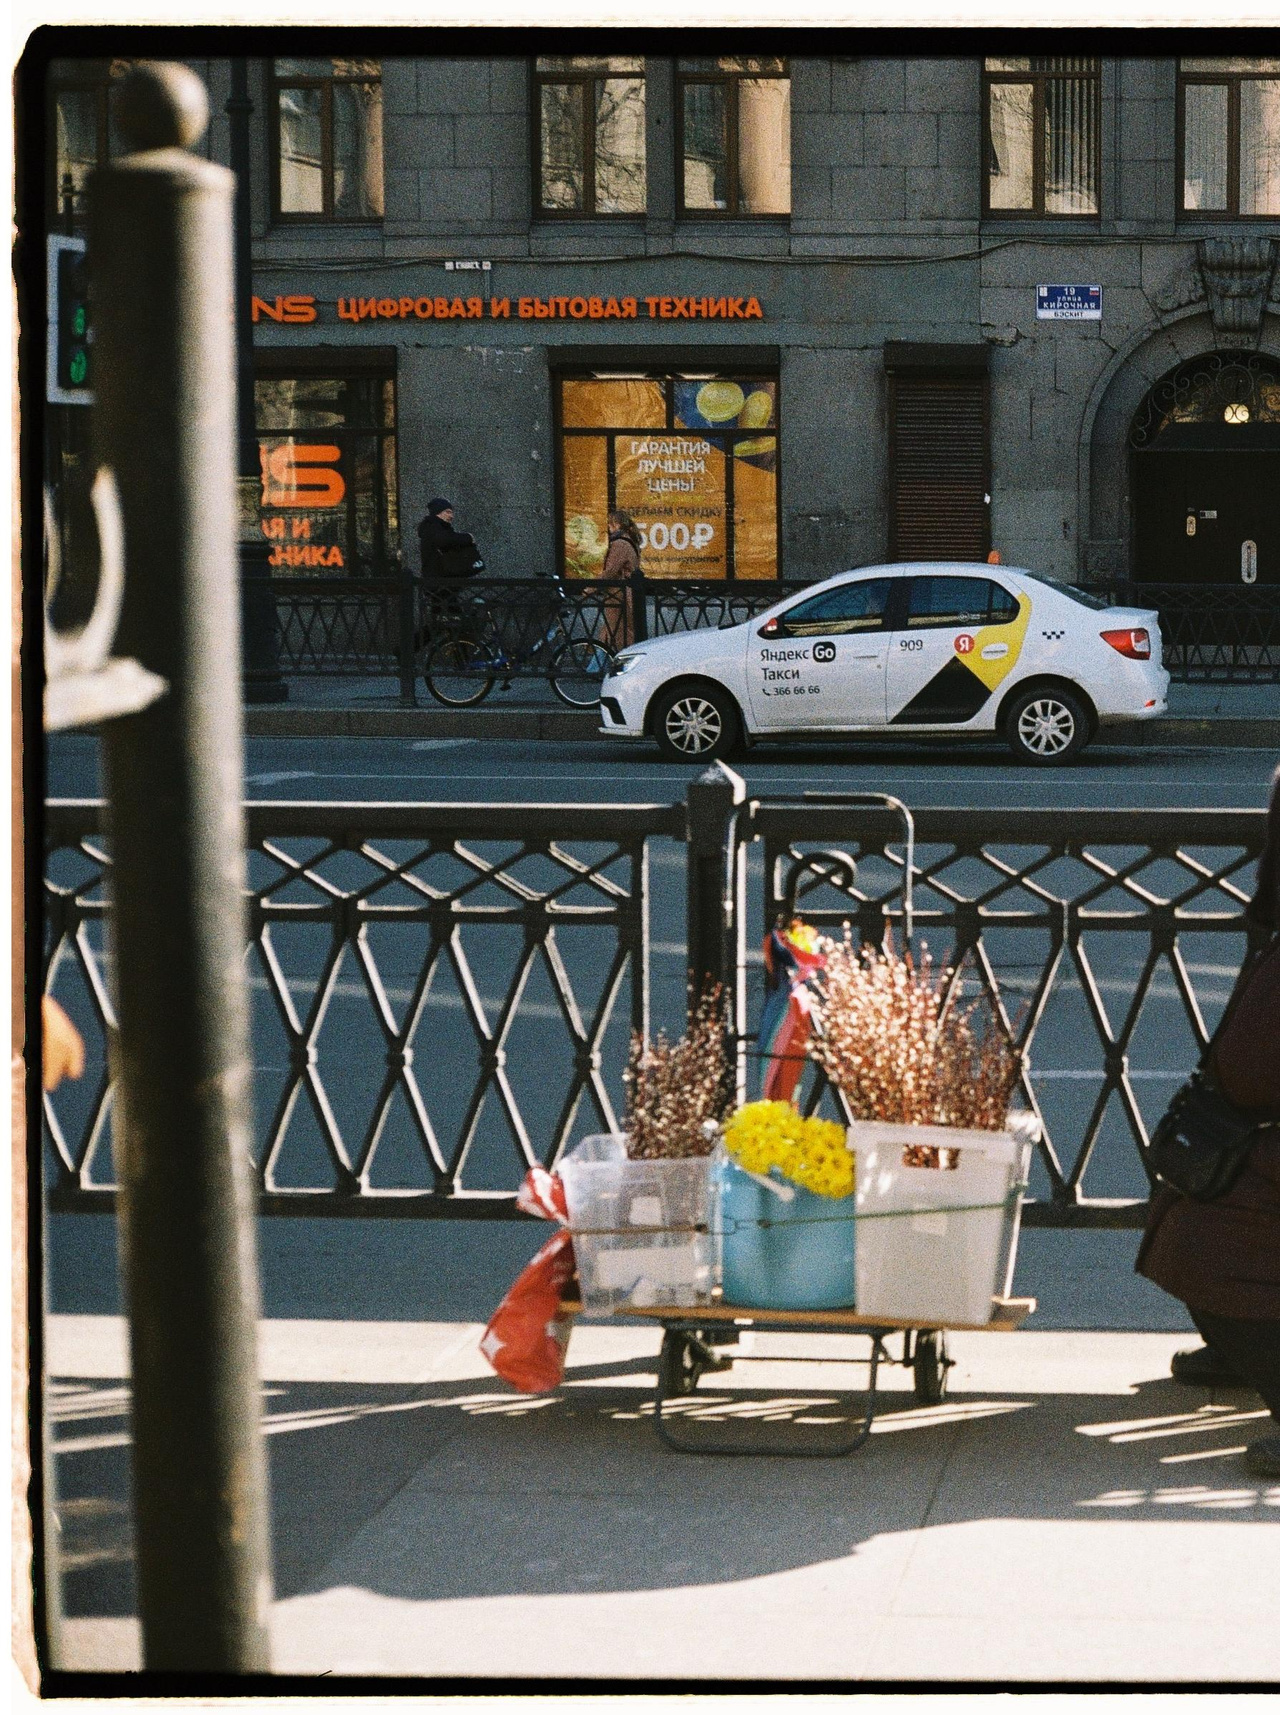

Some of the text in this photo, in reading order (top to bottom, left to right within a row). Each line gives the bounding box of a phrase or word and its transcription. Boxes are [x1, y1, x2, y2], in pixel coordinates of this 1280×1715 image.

[1064, 287, 1076, 296] 19
[251, 295, 317, 323] NS
[337, 297, 763, 323] ЦИФРОВАЯ И БЫТОВАЯ ТЕХНИКА
[1043, 301, 1096, 309] КИРОЧНАЯ
[630, 441, 711, 455] ГАРАНТИЯ
[637, 457, 706, 474] ЛУЧШЕЙ
[647, 478, 695, 493] ЦЕНЫ
[291, 518, 311, 539] И
[900, 639, 923, 651] 909
[760, 645, 834, 662] Яндекс Go
[761, 667, 800, 680] Такси
[773, 685, 820, 696] 366 66 66
